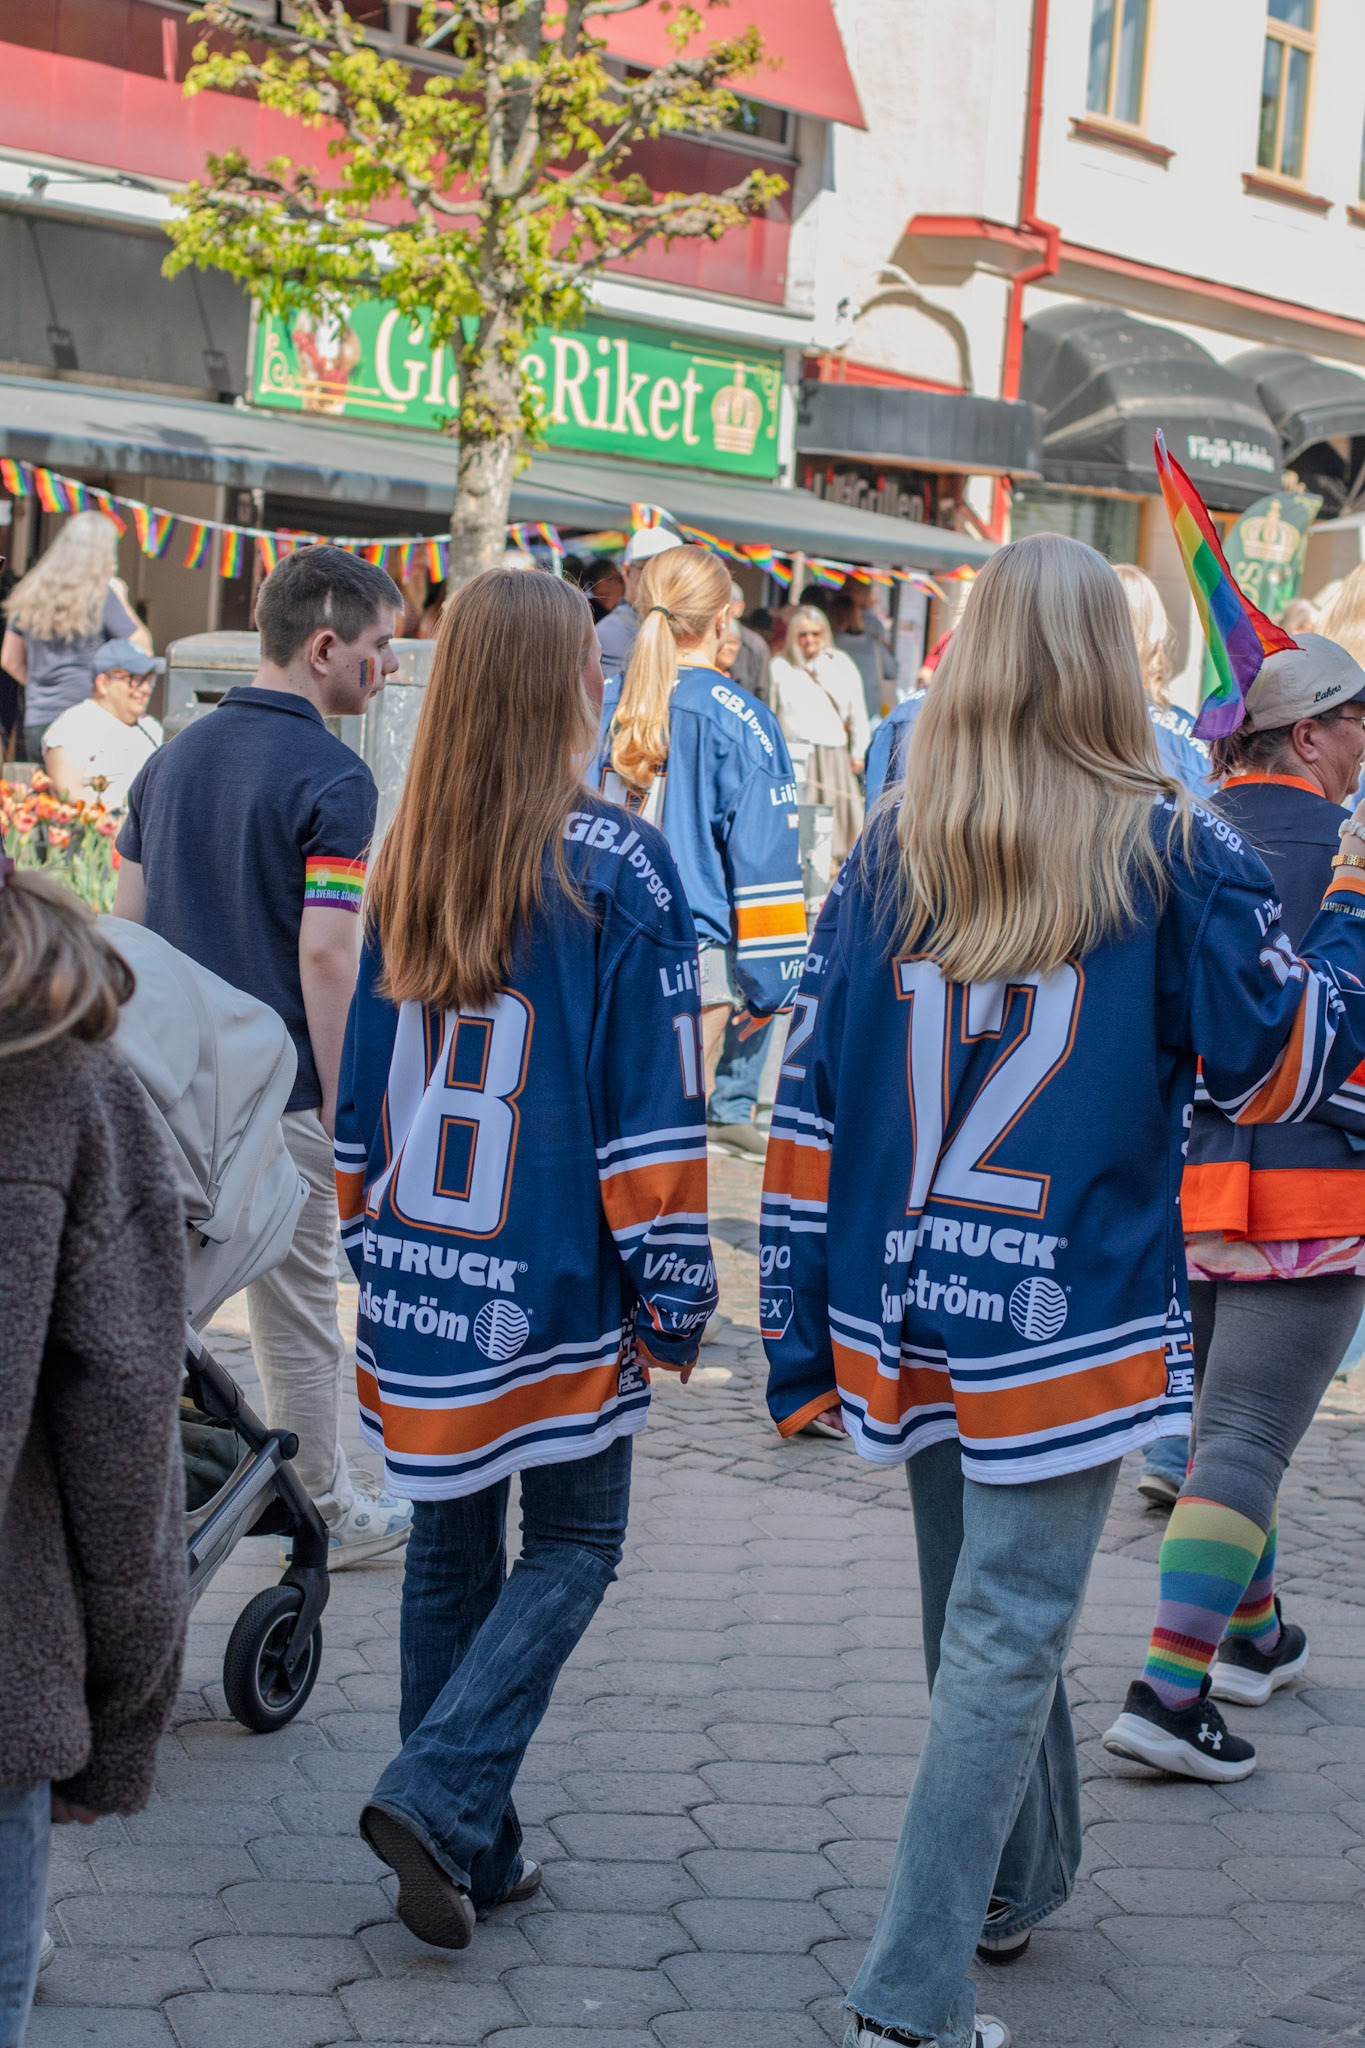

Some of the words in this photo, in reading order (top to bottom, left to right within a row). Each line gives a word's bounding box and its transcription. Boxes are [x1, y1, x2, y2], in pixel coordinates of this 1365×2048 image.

[1312, 683, 1342, 703] Lakers
[316, 888, 341, 900] SVERIGE
[365, 986, 535, 1240] 18
[893, 953, 1085, 1219] 12
[883, 1214, 1060, 1270] SVTRUCK
[880, 1268, 1005, 1324] Suström
